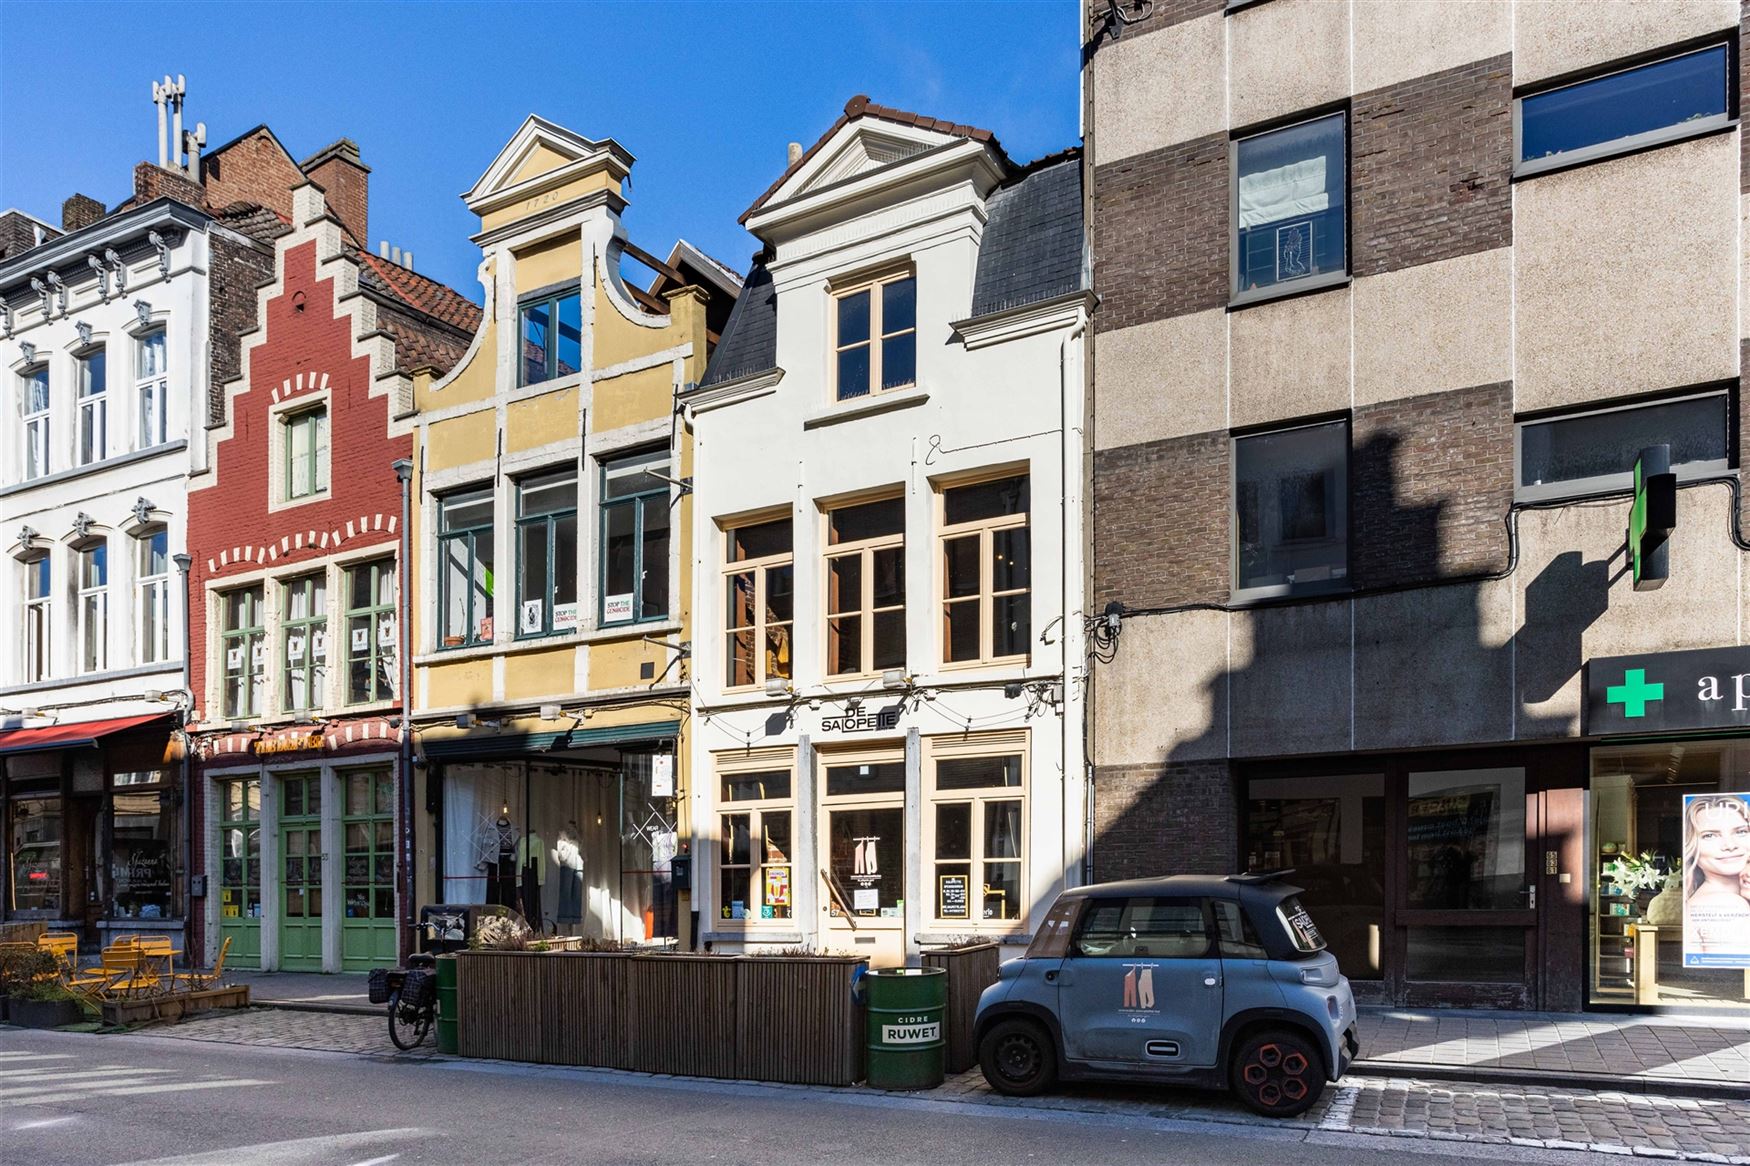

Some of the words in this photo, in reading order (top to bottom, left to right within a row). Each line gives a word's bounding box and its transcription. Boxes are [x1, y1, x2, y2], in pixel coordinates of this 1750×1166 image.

[845, 706, 866, 717] DE
[821, 712, 896, 733] SALOPETTE
[830, 909, 840, 917] 57
[898, 1015, 928, 1024] CIDRE
[887, 1026, 936, 1040] RUWET
